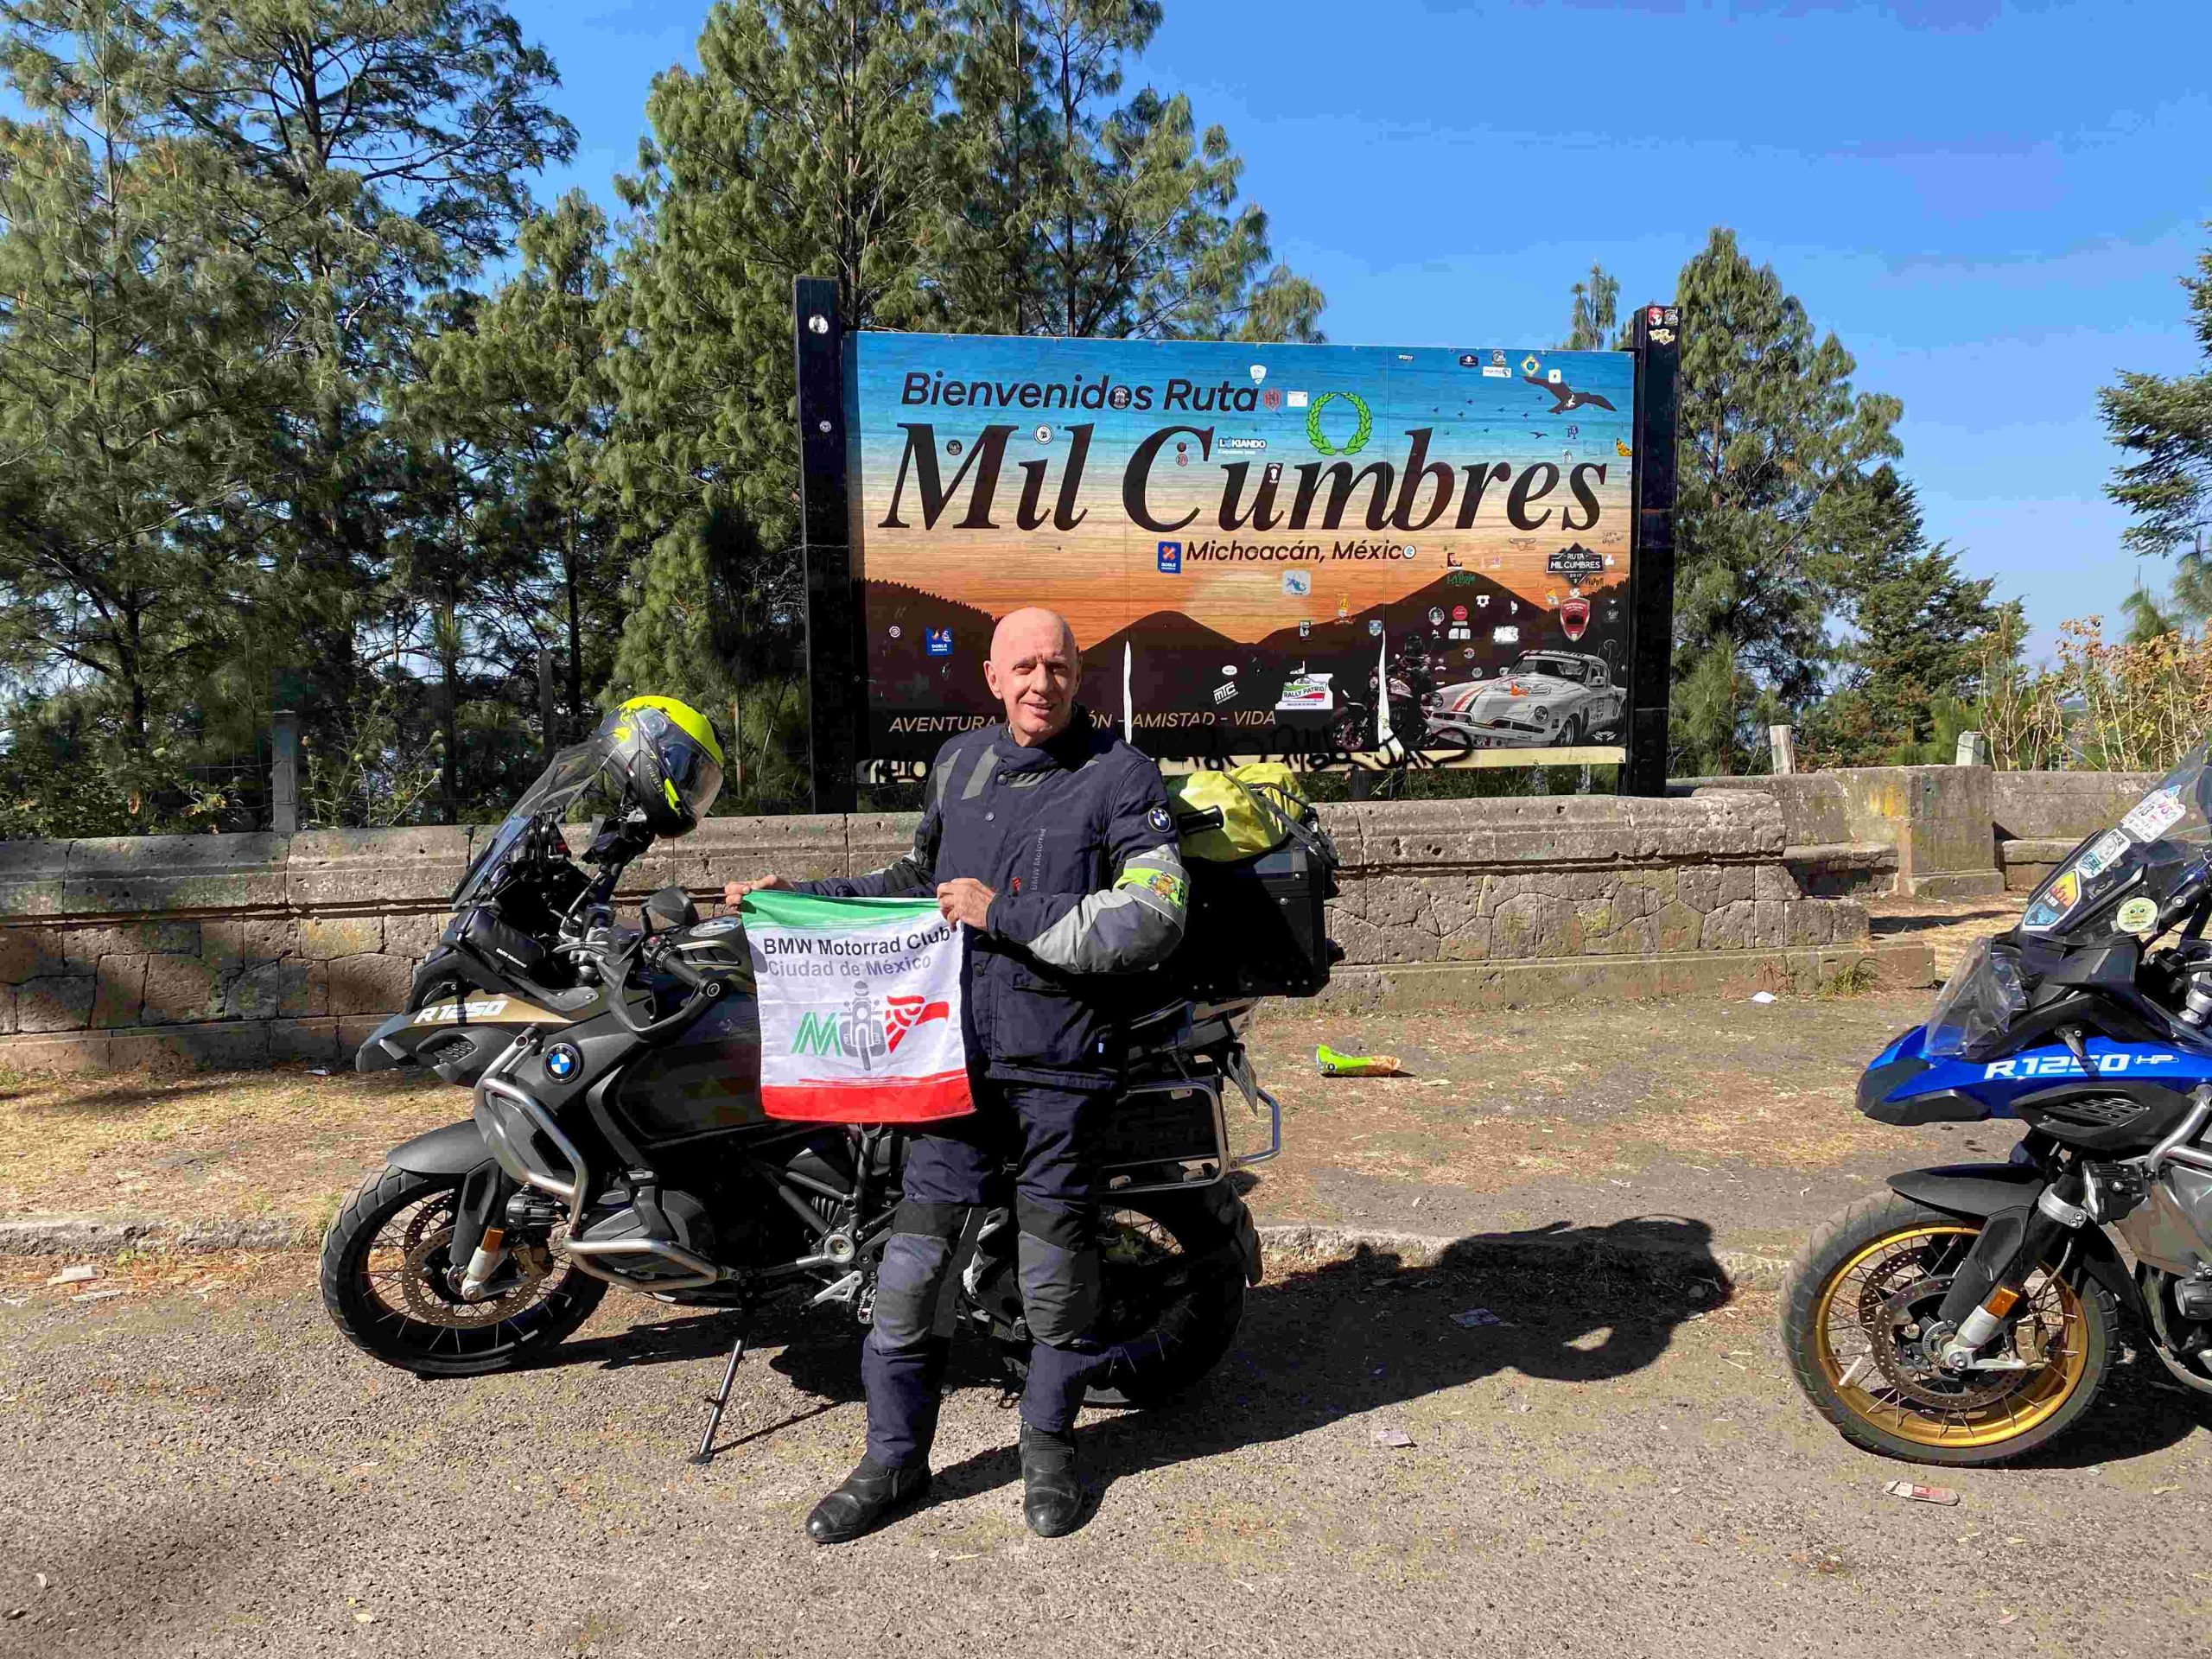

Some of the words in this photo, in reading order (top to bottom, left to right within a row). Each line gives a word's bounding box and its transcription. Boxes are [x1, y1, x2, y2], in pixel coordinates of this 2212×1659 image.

[901, 371, 1154, 410] Bienvenidos
[1163, 378, 1259, 411] Ruta
[878, 422, 1094, 531] Mil
[1122, 425, 1607, 531] Cumbres
[1185, 539, 1325, 563] Michoacán,
[1283, 690, 1302, 698] RALLY
[888, 715, 996, 733] AVENTURA
[1132, 711, 1216, 728] AMISTAD
[1234, 710, 1277, 726] VIDA
[1033, 829, 1046, 866] Motorrad
[764, 938, 812, 955] BMW
[817, 936, 901, 957] Motorrad
[907, 925, 950, 950] Club
[768, 958, 835, 977] Ciudad
[840, 961, 861, 976] de
[867, 955, 931, 976] México
[413, 1006, 440, 1024] R
[437, 1001, 509, 1020] 1250
[1984, 1059, 2017, 1080] R
[2022, 1053, 2131, 1075] 1250
